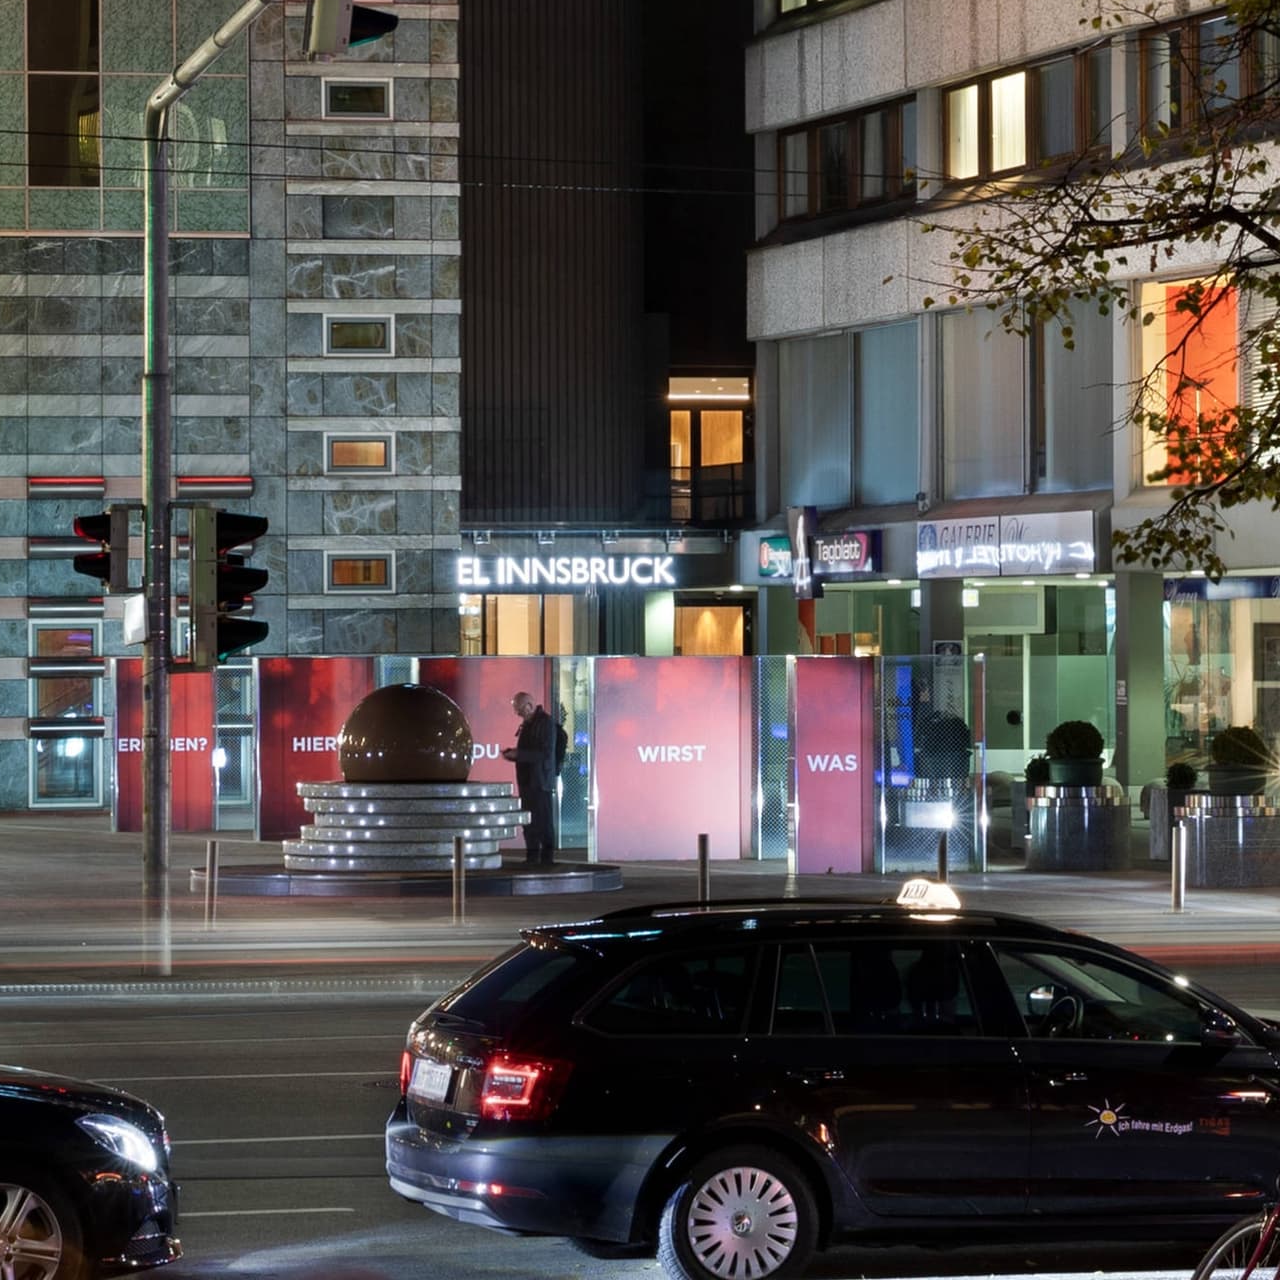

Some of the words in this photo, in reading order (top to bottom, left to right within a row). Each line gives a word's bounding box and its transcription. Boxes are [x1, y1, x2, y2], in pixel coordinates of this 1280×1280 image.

[816, 539, 860, 565] Tagblatt
[497, 557, 676, 585] INNSBRUCK
[118, 739, 207, 753] ERBEN?
[293, 738, 337, 752] HIER
[472, 743, 500, 759] DU
[638, 745, 706, 762] WIRST
[807, 754, 857, 772] WAS
